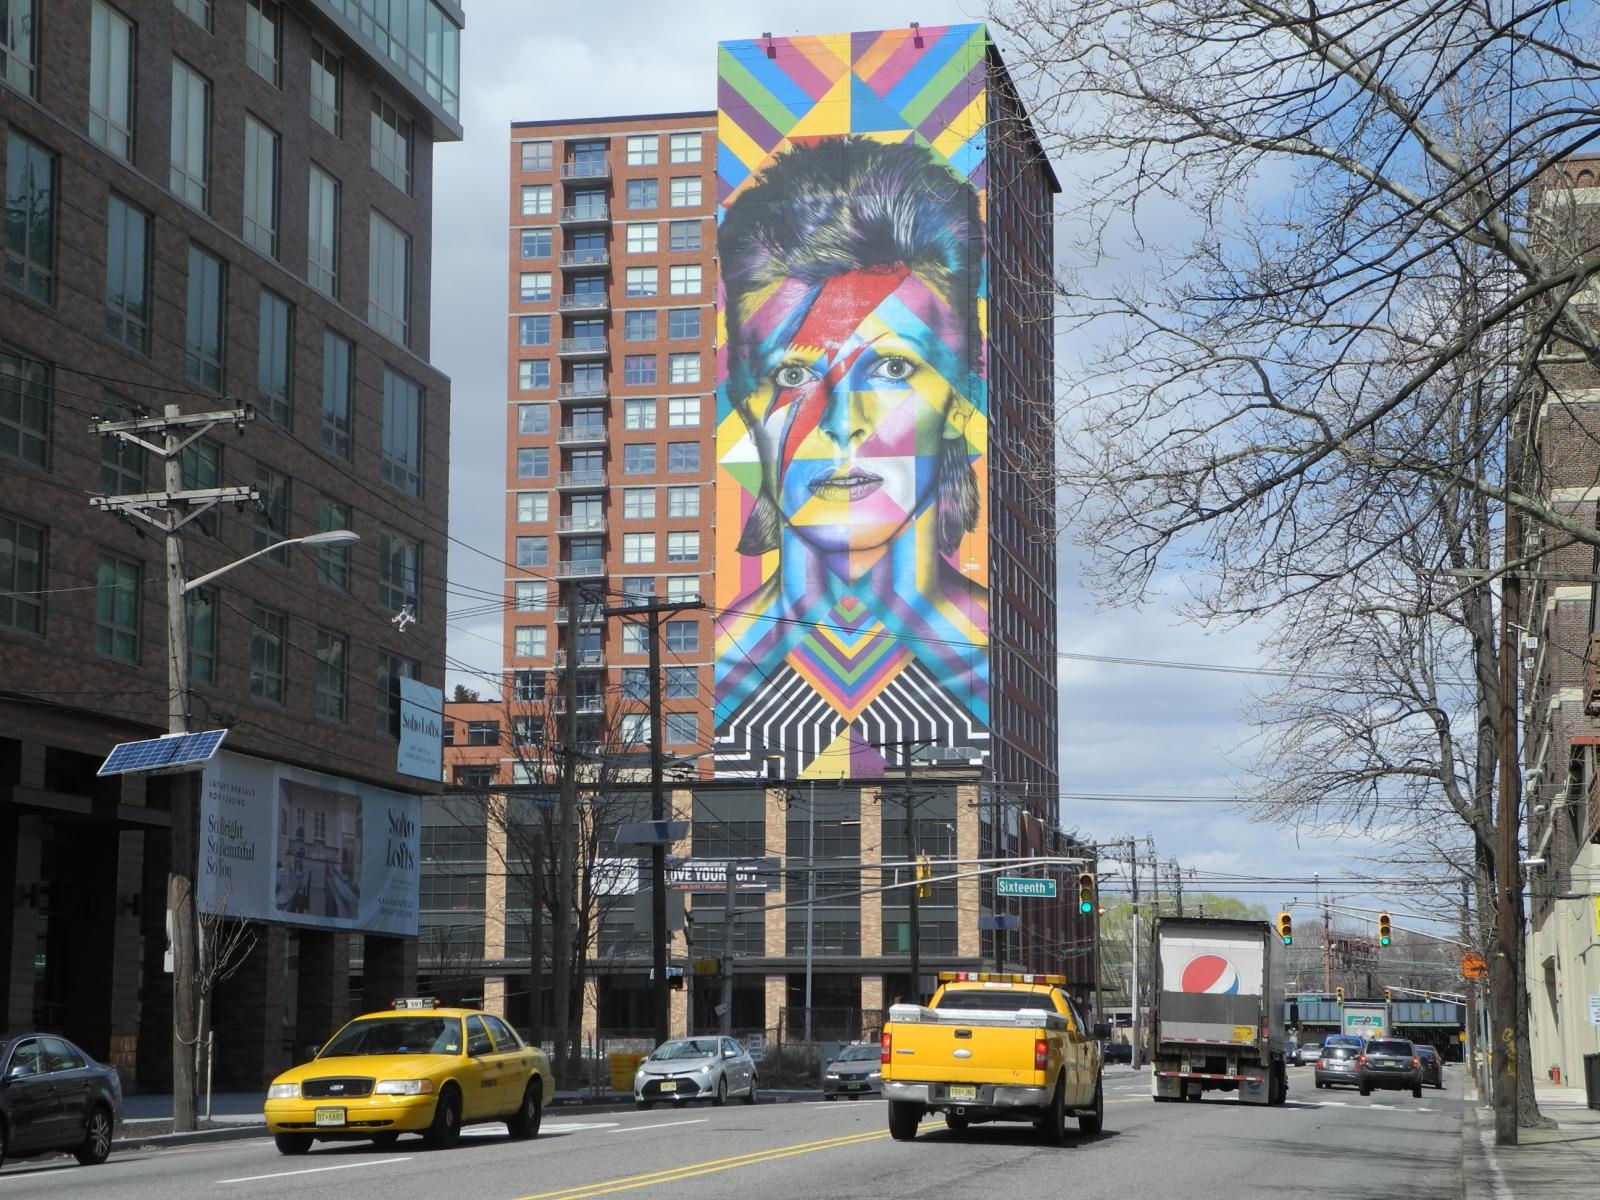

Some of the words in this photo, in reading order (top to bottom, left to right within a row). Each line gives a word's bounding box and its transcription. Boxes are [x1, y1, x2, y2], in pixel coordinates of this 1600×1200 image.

[208, 814, 218, 834] So
[219, 817, 243, 840] Bright
[388, 808, 415, 838] Soho
[207, 835, 218, 855] So
[219, 837, 255, 861] Beautiful
[386, 839, 415, 870] Lofts
[206, 856, 217, 875] So
[218, 858, 232, 878] You
[694, 867, 727, 881] YOUR
[735, 866, 758, 881] OFT
[1000, 881, 1046, 893] Sixteenth
